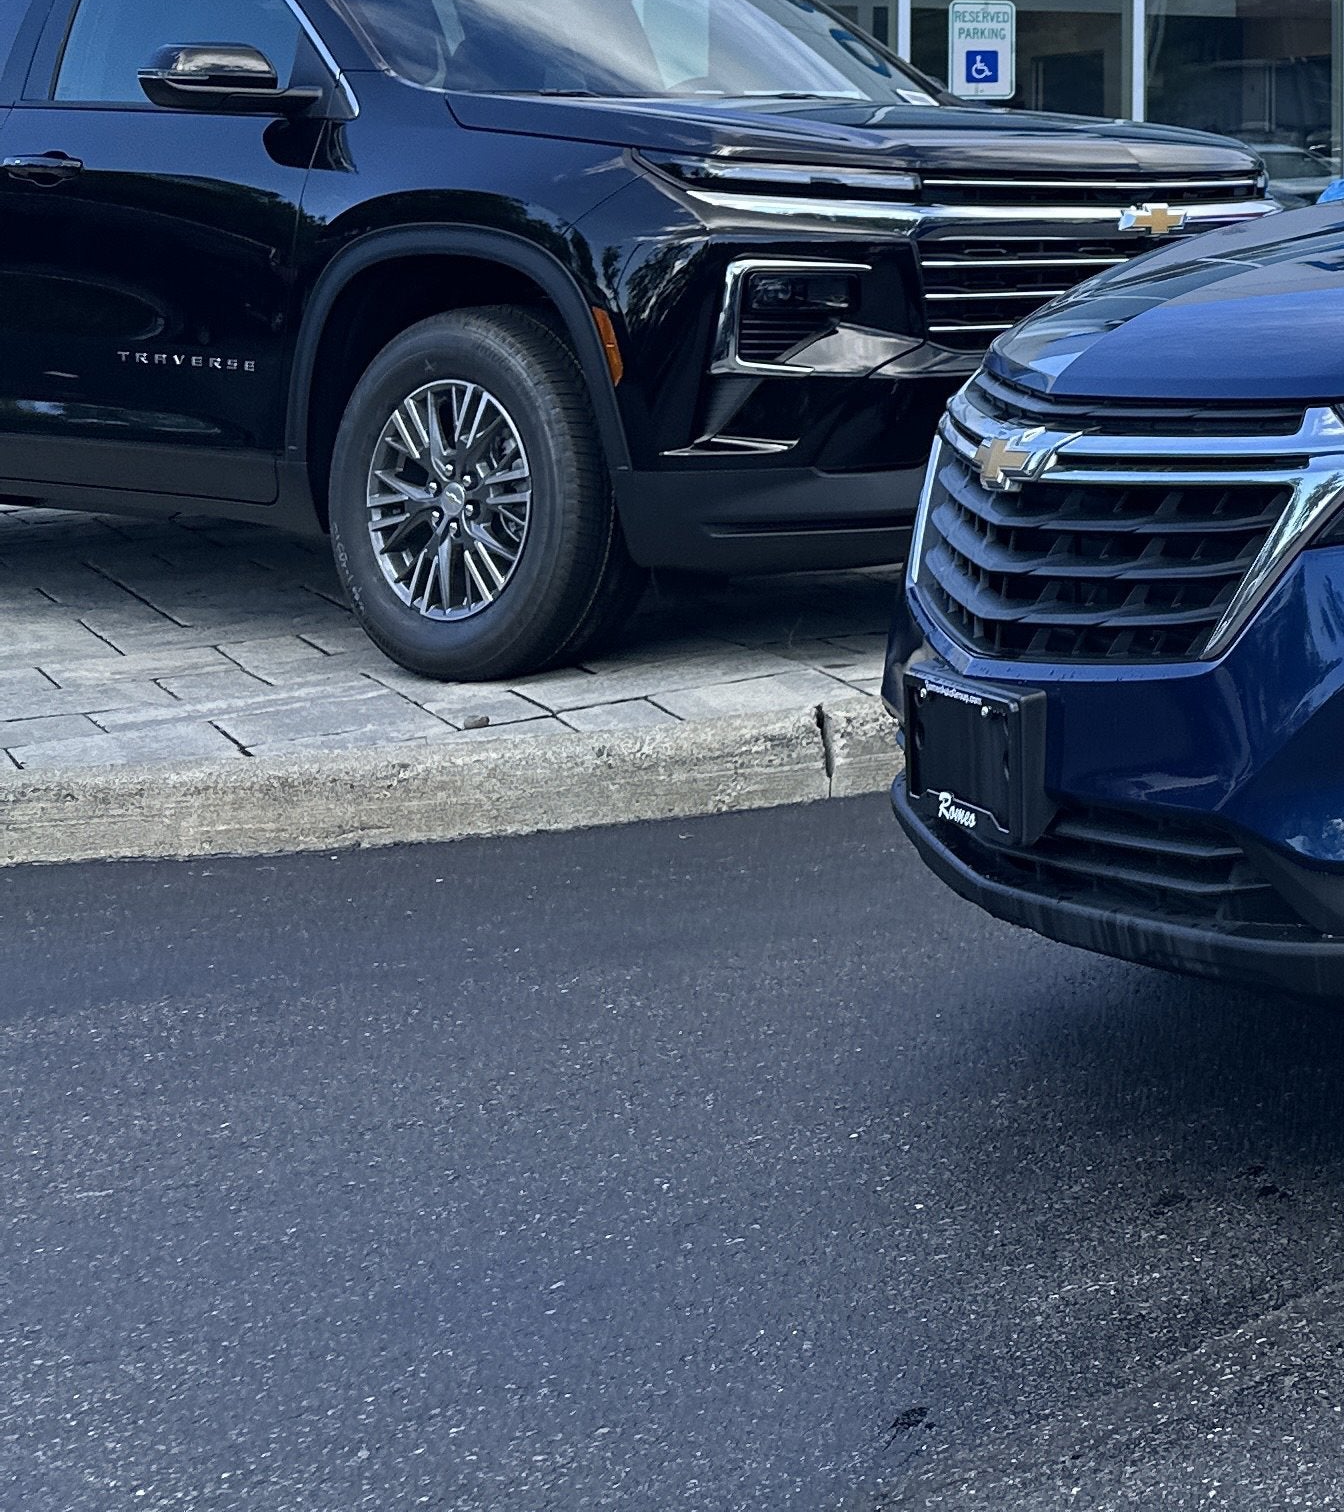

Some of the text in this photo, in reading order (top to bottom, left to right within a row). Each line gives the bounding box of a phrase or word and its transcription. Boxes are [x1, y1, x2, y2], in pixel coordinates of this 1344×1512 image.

[954, 11, 1010, 24] RESERVED
[958, 27, 1007, 40] PARKING
[117, 351, 256, 372] TRAVERSE
[937, 791, 977, 829] Romeo
